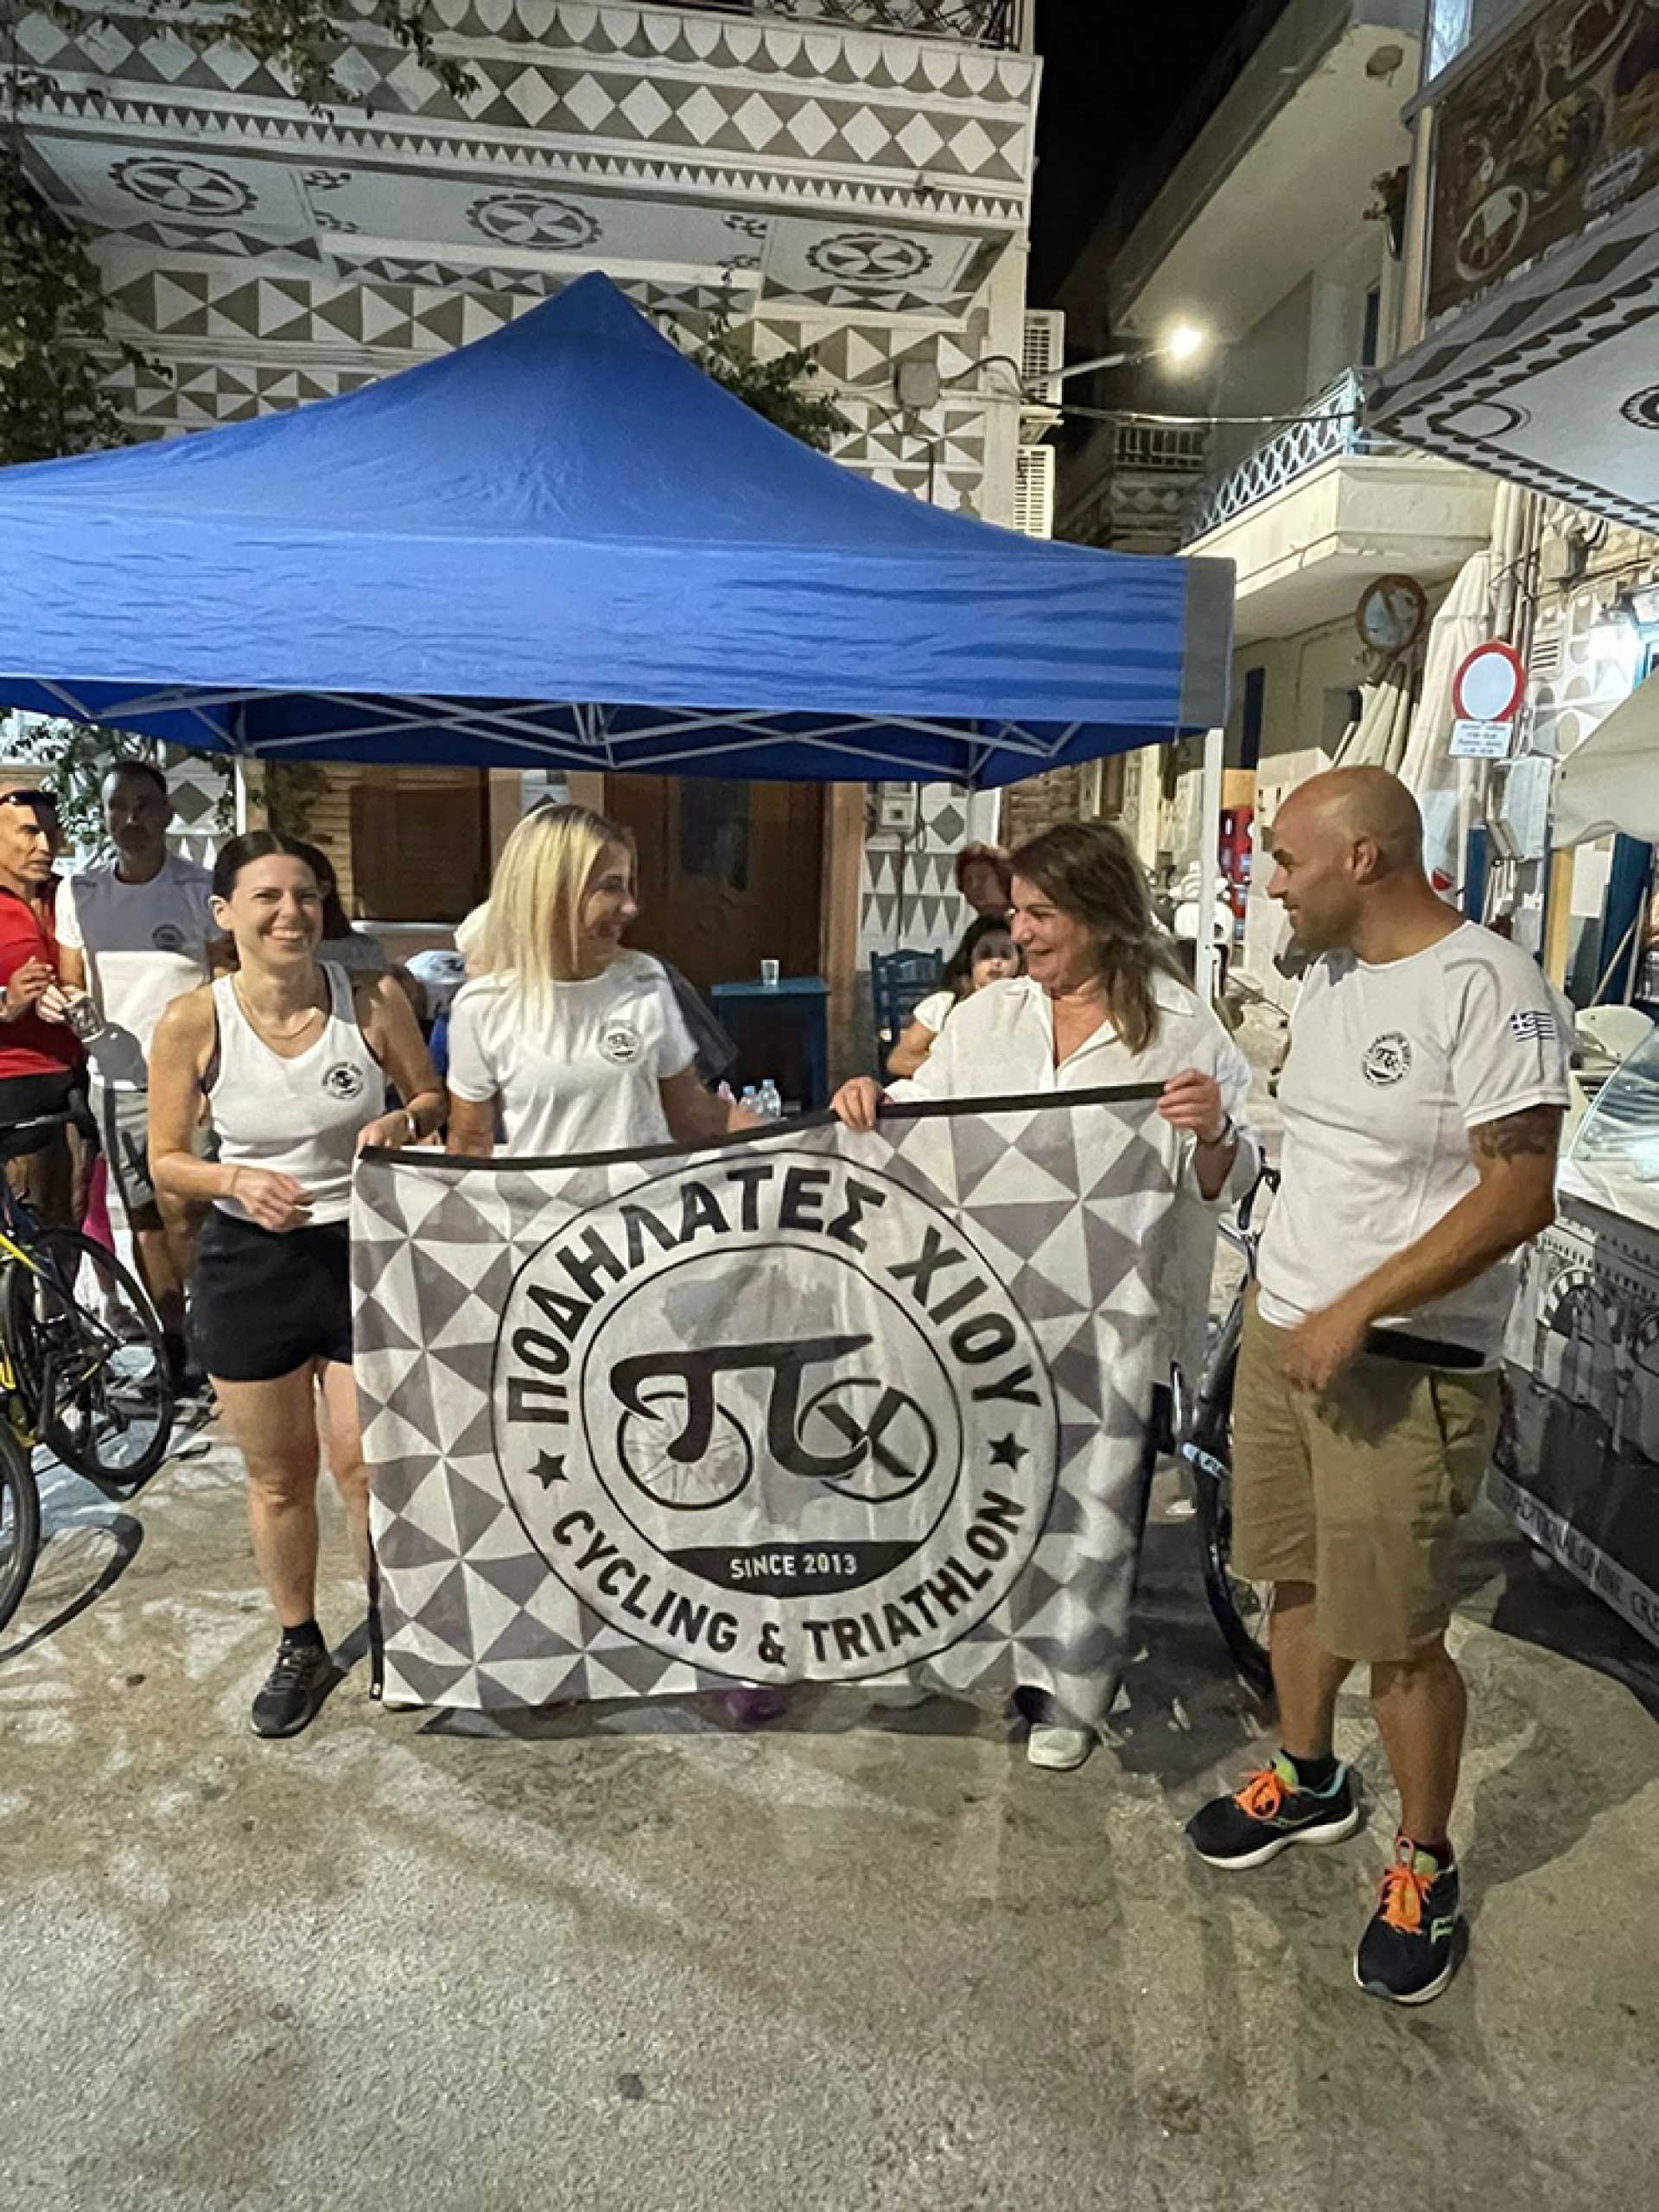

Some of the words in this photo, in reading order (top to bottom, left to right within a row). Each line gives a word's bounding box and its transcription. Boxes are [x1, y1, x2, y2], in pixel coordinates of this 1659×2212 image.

[507, 1165, 887, 1425] ΠΟΔΗΛΑΤΕΣ
[885, 1224, 1042, 1407] ΧΙΟΥ
[552, 1510, 739, 1653] CYCLING
[758, 1621, 788, 1667] &
[802, 1489, 1026, 1662] TRIATHLON
[730, 1554, 797, 1580] SINCE
[803, 1552, 858, 1576] 2013
